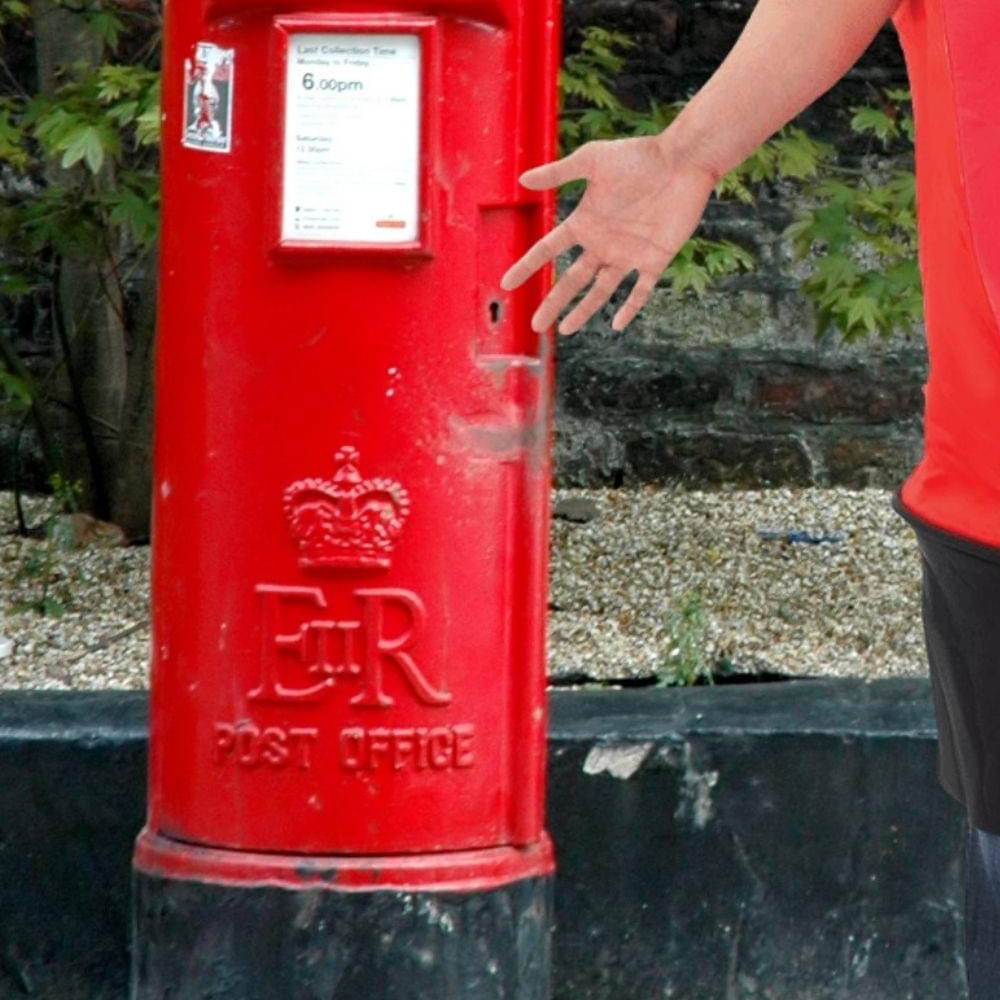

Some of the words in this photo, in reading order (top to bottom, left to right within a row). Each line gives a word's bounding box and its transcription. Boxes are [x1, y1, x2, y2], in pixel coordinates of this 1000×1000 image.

[296, 45, 319, 55] Last
[321, 45, 370, 55] Collection
[373, 46, 397, 55] Time
[296, 58, 330, 66] Monday
[343, 58, 370, 68] Friday
[302, 72, 364, 92] 6.00pm
[213, 723, 319, 767] POST
[340, 723, 475, 768] OFFICE
